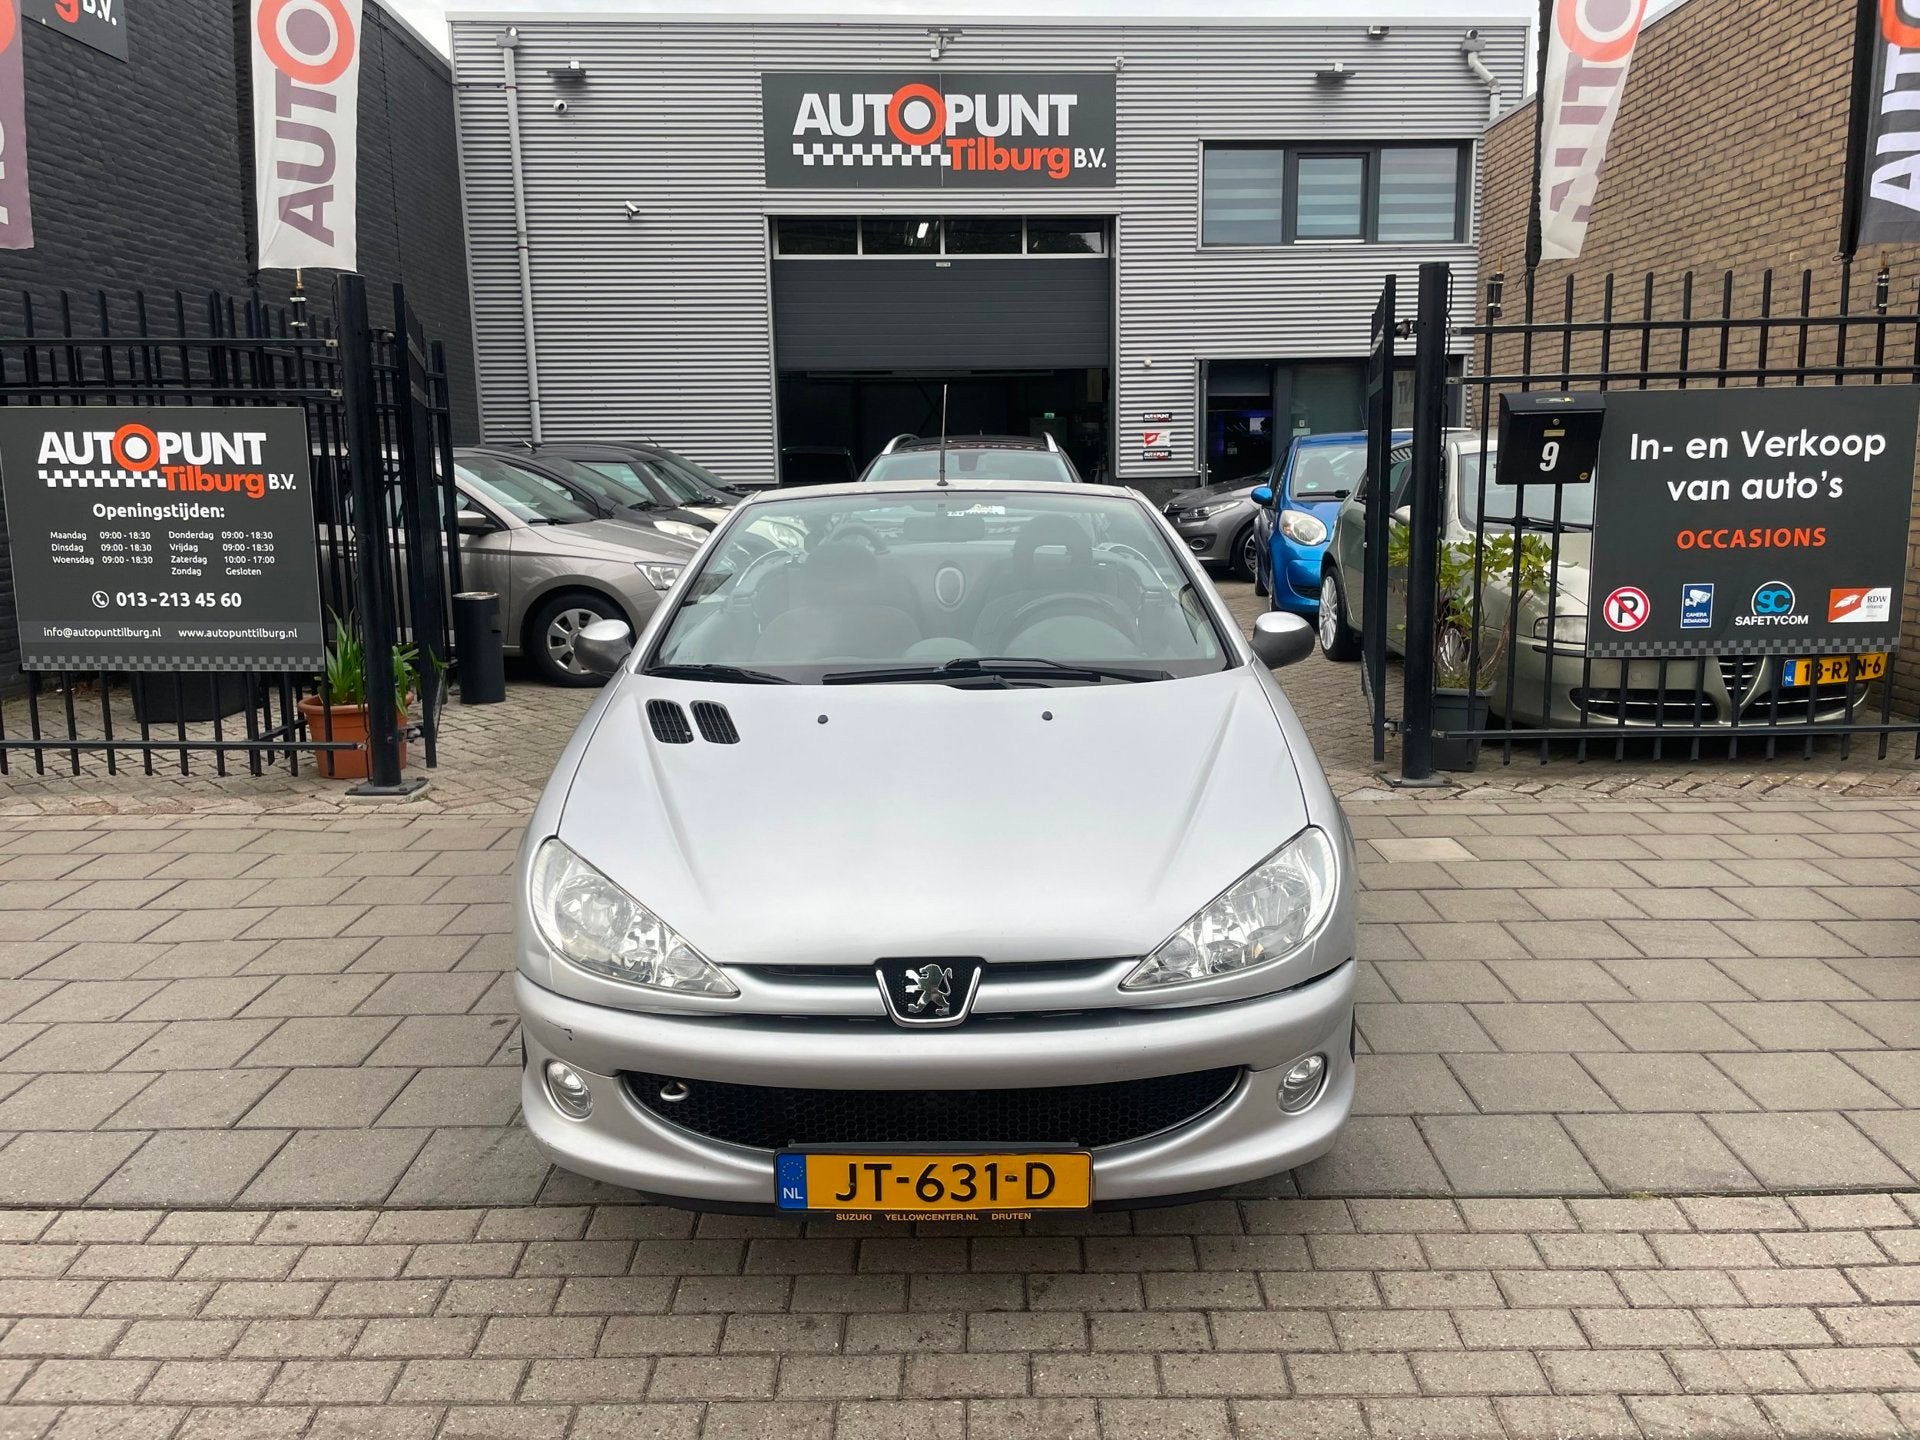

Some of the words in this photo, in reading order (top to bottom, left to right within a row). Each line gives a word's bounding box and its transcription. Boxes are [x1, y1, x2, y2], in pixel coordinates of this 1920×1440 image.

[792, 83, 1078, 146] AUTOPUNT
[946, 136, 1070, 180] Tilburg
[1074, 147, 1107, 169] B.V.
[37, 423, 266, 472] AUTOPUNT
[1630, 433, 1673, 460] In-
[1686, 435, 1728, 458] en
[1741, 429, 1887, 462] Verkoop
[1540, 441, 1560, 472] 9
[162, 466, 265, 499] Tilburg
[268, 473, 296, 490] B.V.
[1667, 479, 1730, 501] van
[1741, 470, 1843, 500] auto's
[92, 503, 225, 520] Openingstijden:
[50, 531, 87, 540] Maandag
[100, 531, 122, 539] 09:00
[129, 531, 151, 539] 18:30
[169, 531, 214, 540] Donderdag
[222, 531, 244, 539] 09:00
[251, 531, 273, 539] 18:30
[1676, 527, 1827, 550] OCCASIONS
[51, 543, 84, 552] Dinsdag
[101, 544, 123, 552] 09:00
[130, 544, 152, 552] 18:30
[170, 543, 198, 552] Vrijdag
[223, 544, 244, 552] 09:00
[252, 544, 274, 552] 18:30
[52, 555, 94, 564] Woensdag
[102, 556, 124, 564] 09:00
[131, 556, 153, 564] 18:30
[170, 555, 207, 564] Zaterdag
[224, 556, 246, 564] 10:00
[253, 556, 275, 564] 17:00
[171, 567, 202, 576] Zondag
[226, 567, 261, 576] Gesloten
[195, 593, 216, 607] 45
[221, 593, 242, 607] 60
[1735, 615, 1809, 626] SAFETYCOM
[43, 626, 162, 639] info@autopunttilburg.nl
[178, 628, 298, 639] www.autopunttilburg.nl
[835, 1161, 1056, 1202] JT-631-D
[783, 1187, 804, 1200] NL
[836, 1213, 872, 1222] SUZUKI
[885, 1213, 979, 1222] YELLOWCENTER.NL
[991, 1212, 1032, 1220] DRUTEN
